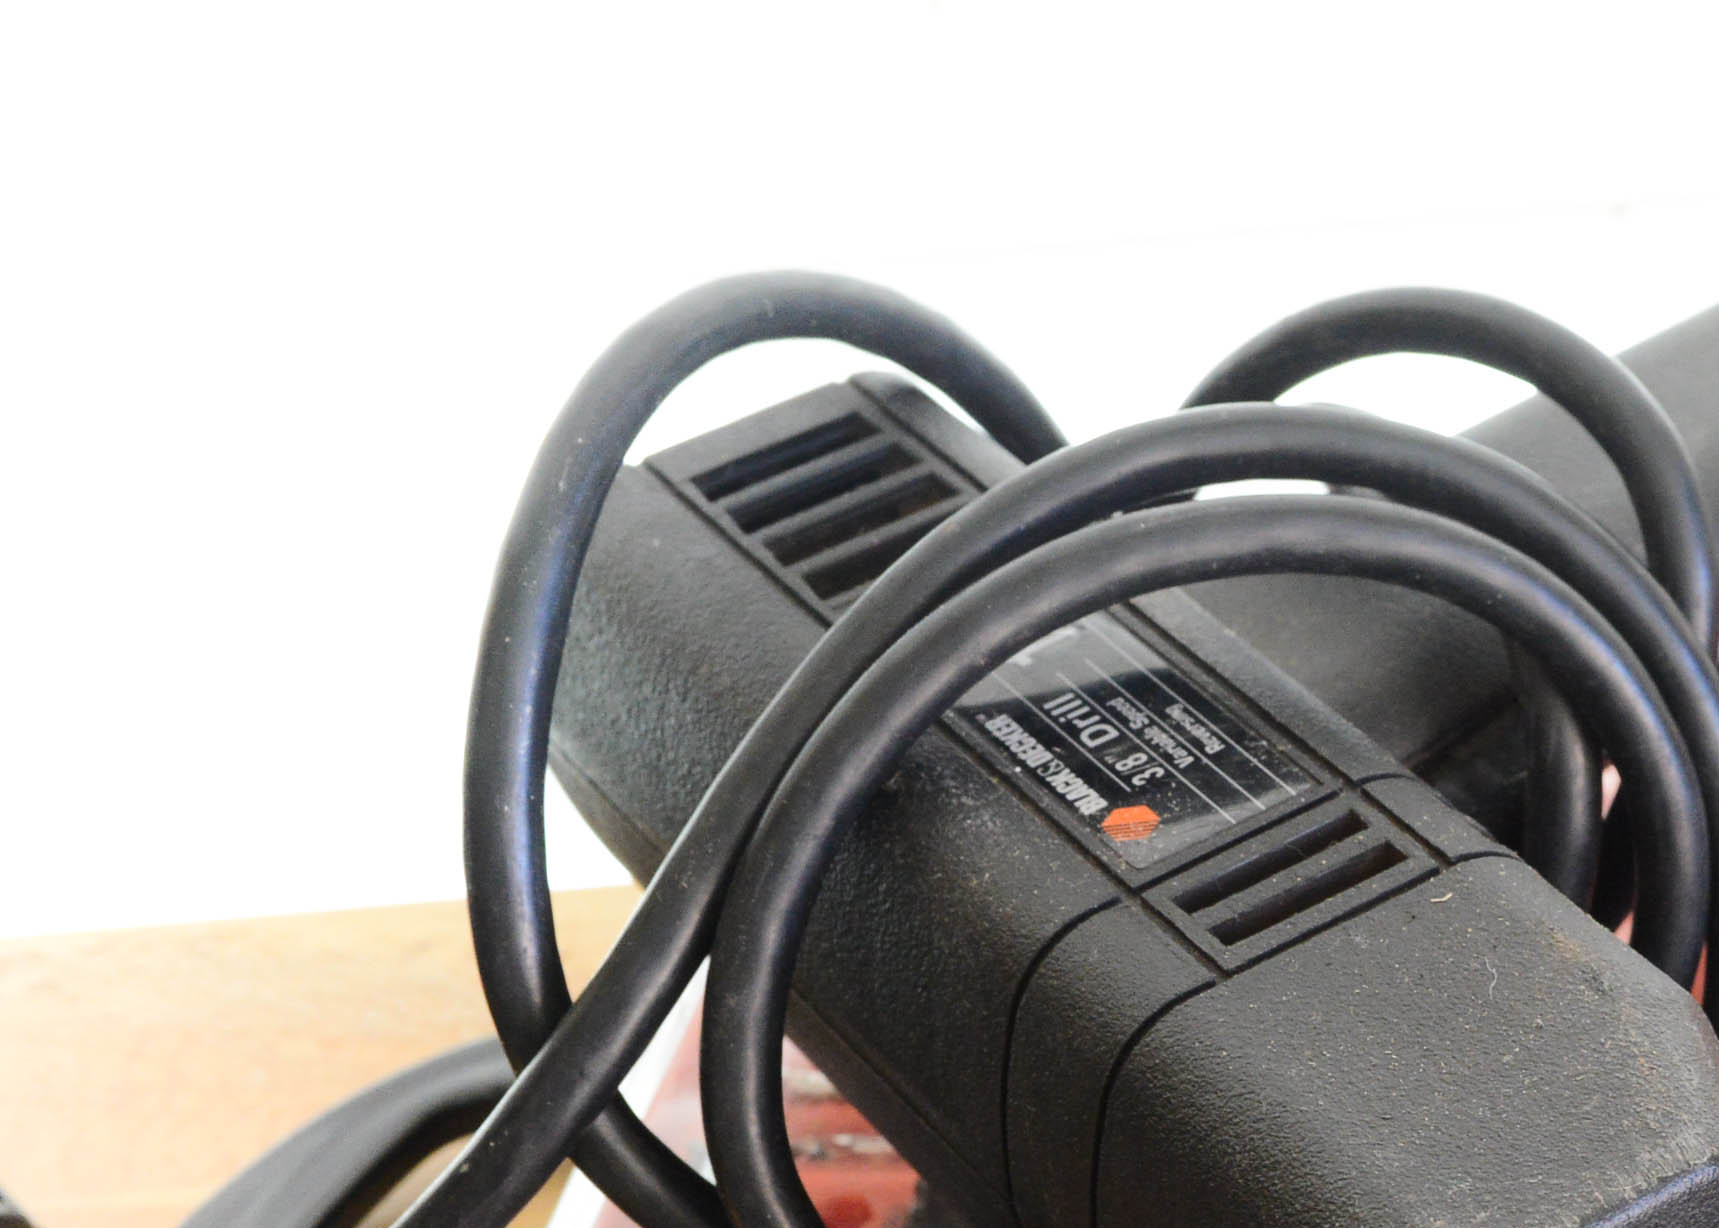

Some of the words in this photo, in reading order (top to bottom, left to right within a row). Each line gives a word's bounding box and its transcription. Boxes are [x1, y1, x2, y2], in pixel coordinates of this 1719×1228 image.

[1043, 693, 1120, 748] Drill
[1106, 697, 1150, 729] Speed
[1165, 703, 1226, 754] Reversing
[1144, 726, 1195, 769] Variable
